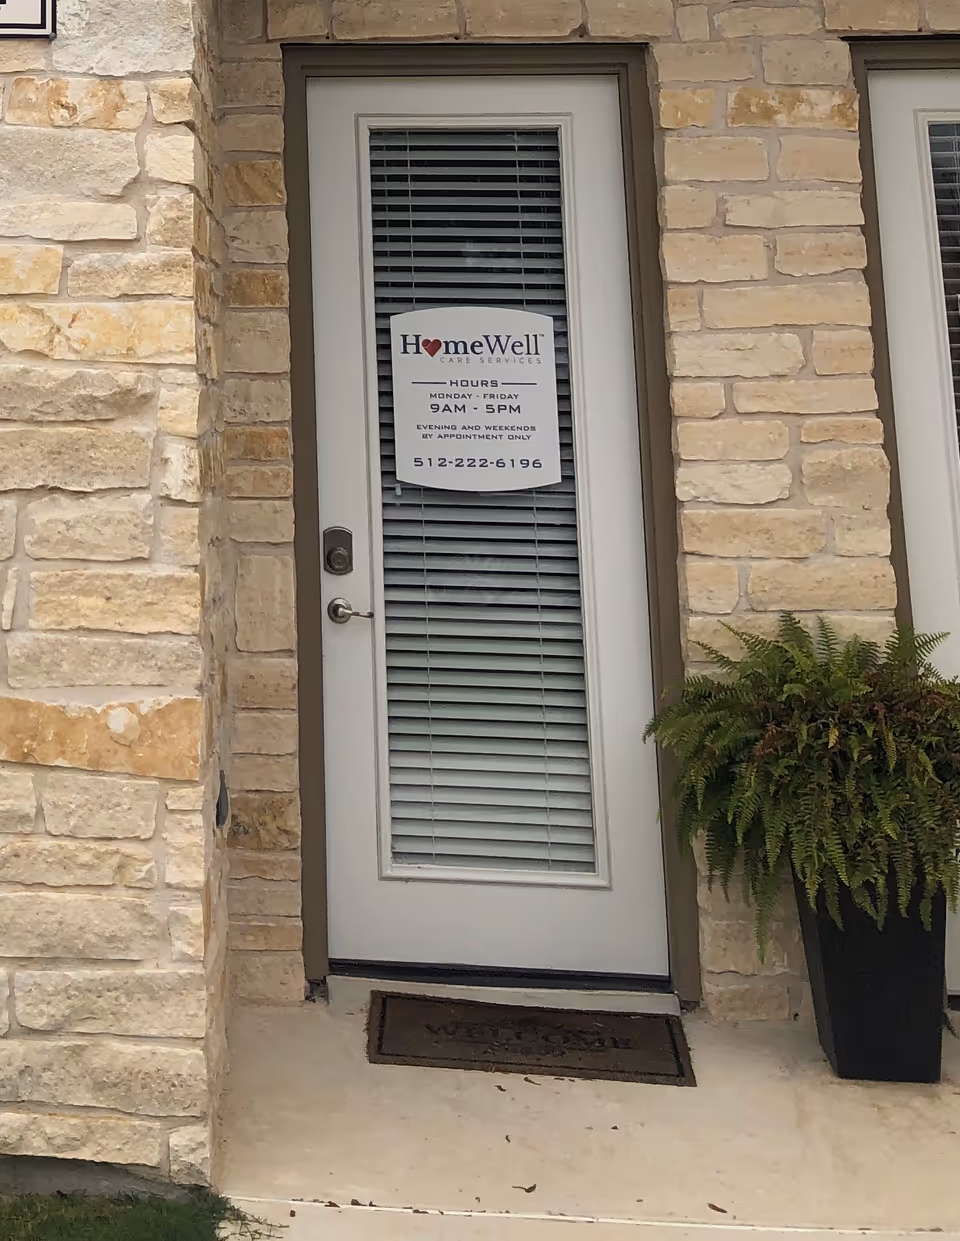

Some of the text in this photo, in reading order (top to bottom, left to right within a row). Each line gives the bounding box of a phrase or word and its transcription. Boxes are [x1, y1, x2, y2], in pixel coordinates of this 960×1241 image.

[480, 357, 542, 365] SERVICES
[449, 379, 499, 388] HOURS
[429, 392, 473, 400] MONDAY
[430, 403, 467, 413] 9AM
[485, 404, 521, 414] 5PM
[413, 457, 542, 469] 512-222-6196
